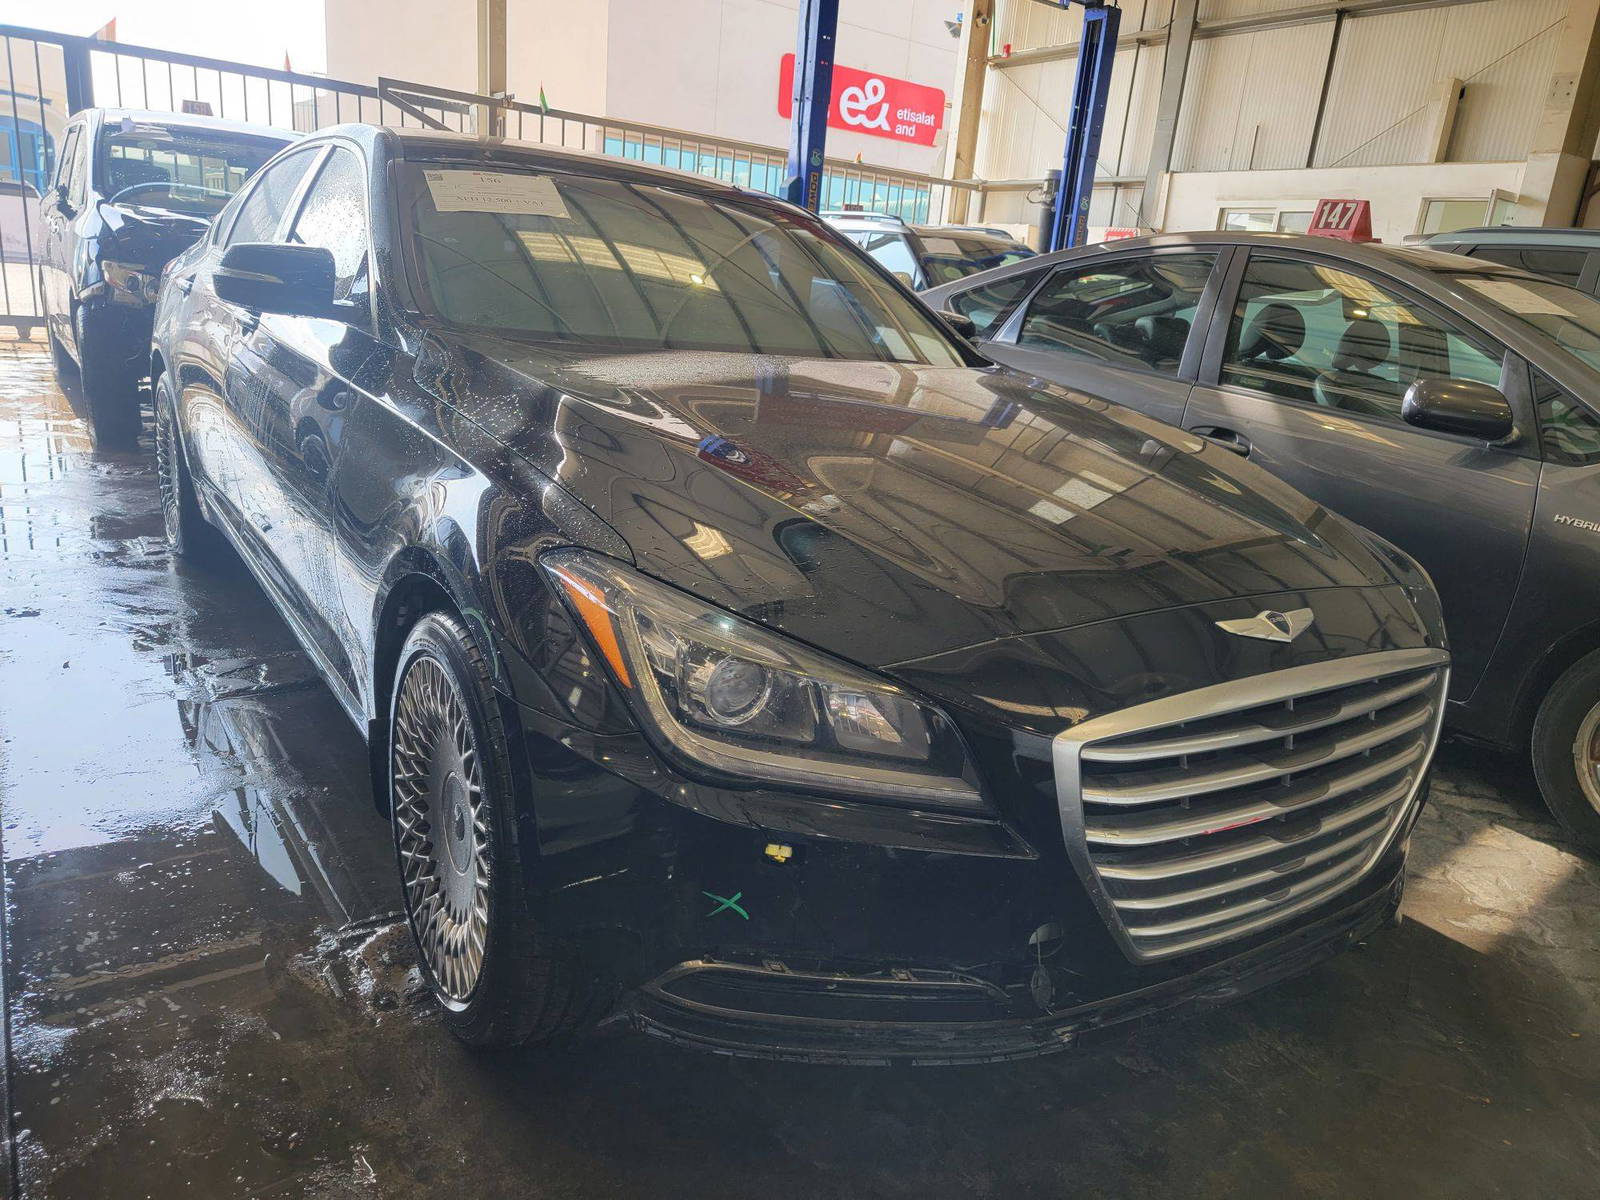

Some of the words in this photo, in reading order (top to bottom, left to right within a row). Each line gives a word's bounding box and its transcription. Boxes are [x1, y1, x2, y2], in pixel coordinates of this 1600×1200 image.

[896, 108, 936, 127] etisalat
[895, 124, 916, 137] and
[1318, 202, 1358, 229] 147
